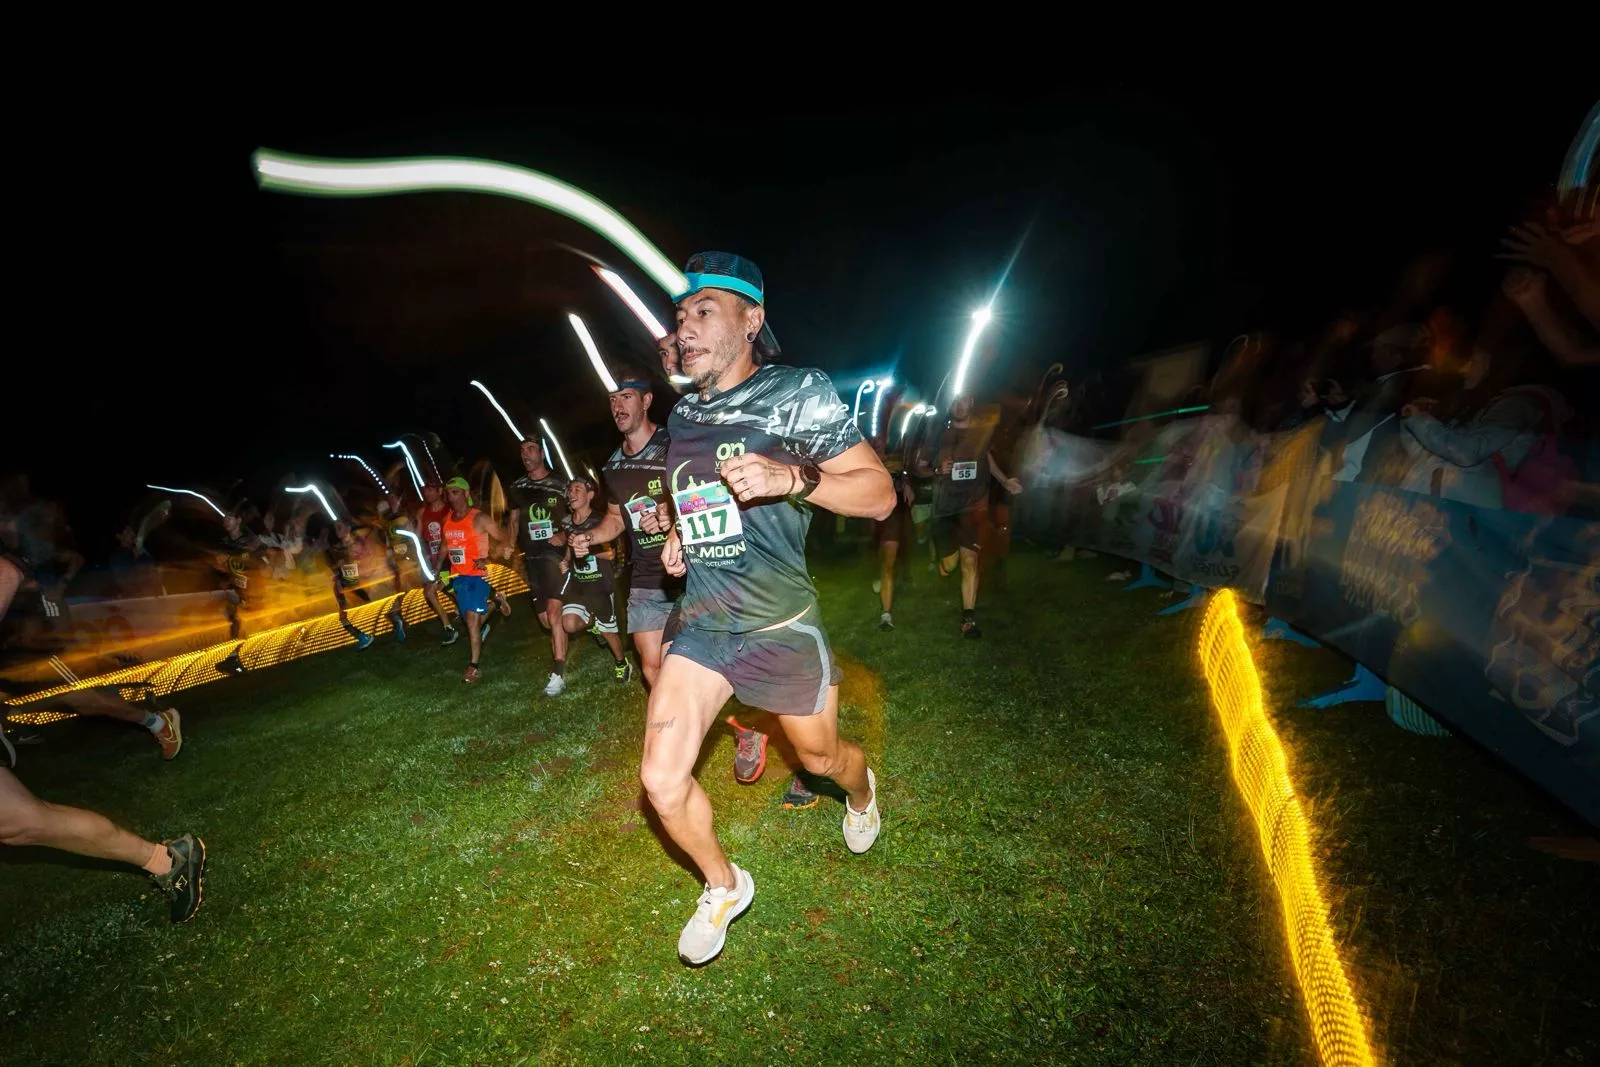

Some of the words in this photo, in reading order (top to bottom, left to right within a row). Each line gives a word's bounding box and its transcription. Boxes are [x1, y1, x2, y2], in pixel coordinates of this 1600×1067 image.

[958, 470, 971, 478] 55
[687, 509, 727, 540] 117
[534, 530, 547, 538] 58
[699, 540, 746, 558] MOON
